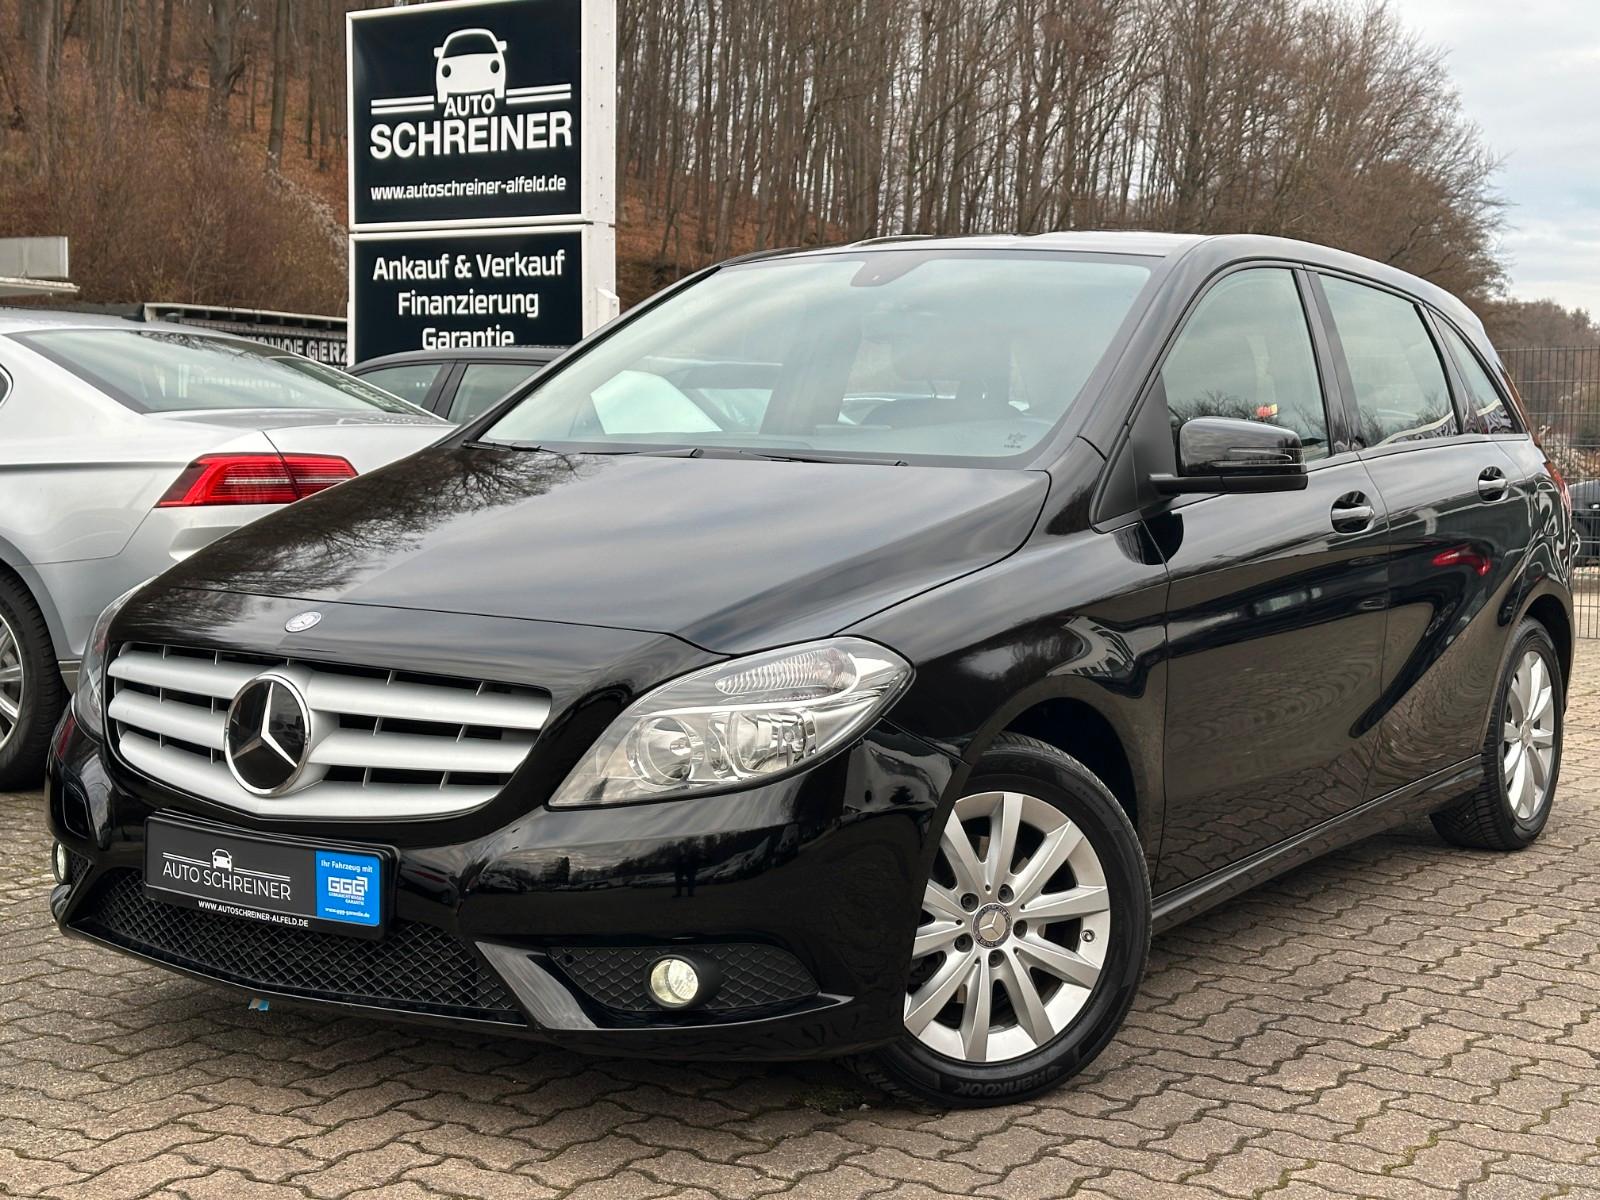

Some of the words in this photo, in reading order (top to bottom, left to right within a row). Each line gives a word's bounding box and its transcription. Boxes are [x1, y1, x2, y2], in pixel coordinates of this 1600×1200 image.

[443, 94, 496, 117] AUTO
[370, 110, 573, 159] SCHREINER
[370, 174, 566, 200] www.autoschreiner-alfeld.de
[372, 253, 450, 280] Ankauf
[454, 254, 472, 278] &
[476, 249, 566, 278] Verkauf
[398, 288, 539, 318] Finanzierung
[422, 324, 515, 350] Garantie
[321, 859, 330, 868] Ihr
[331, 861, 361, 873] Fahrzeug
[162, 861, 200, 883] AUTO
[203, 869, 291, 901] SCHREINER
[328, 876, 366, 896] GGG
[198, 900, 309, 927] WWW.AUTOSCHREINER-ALFELD.DE
